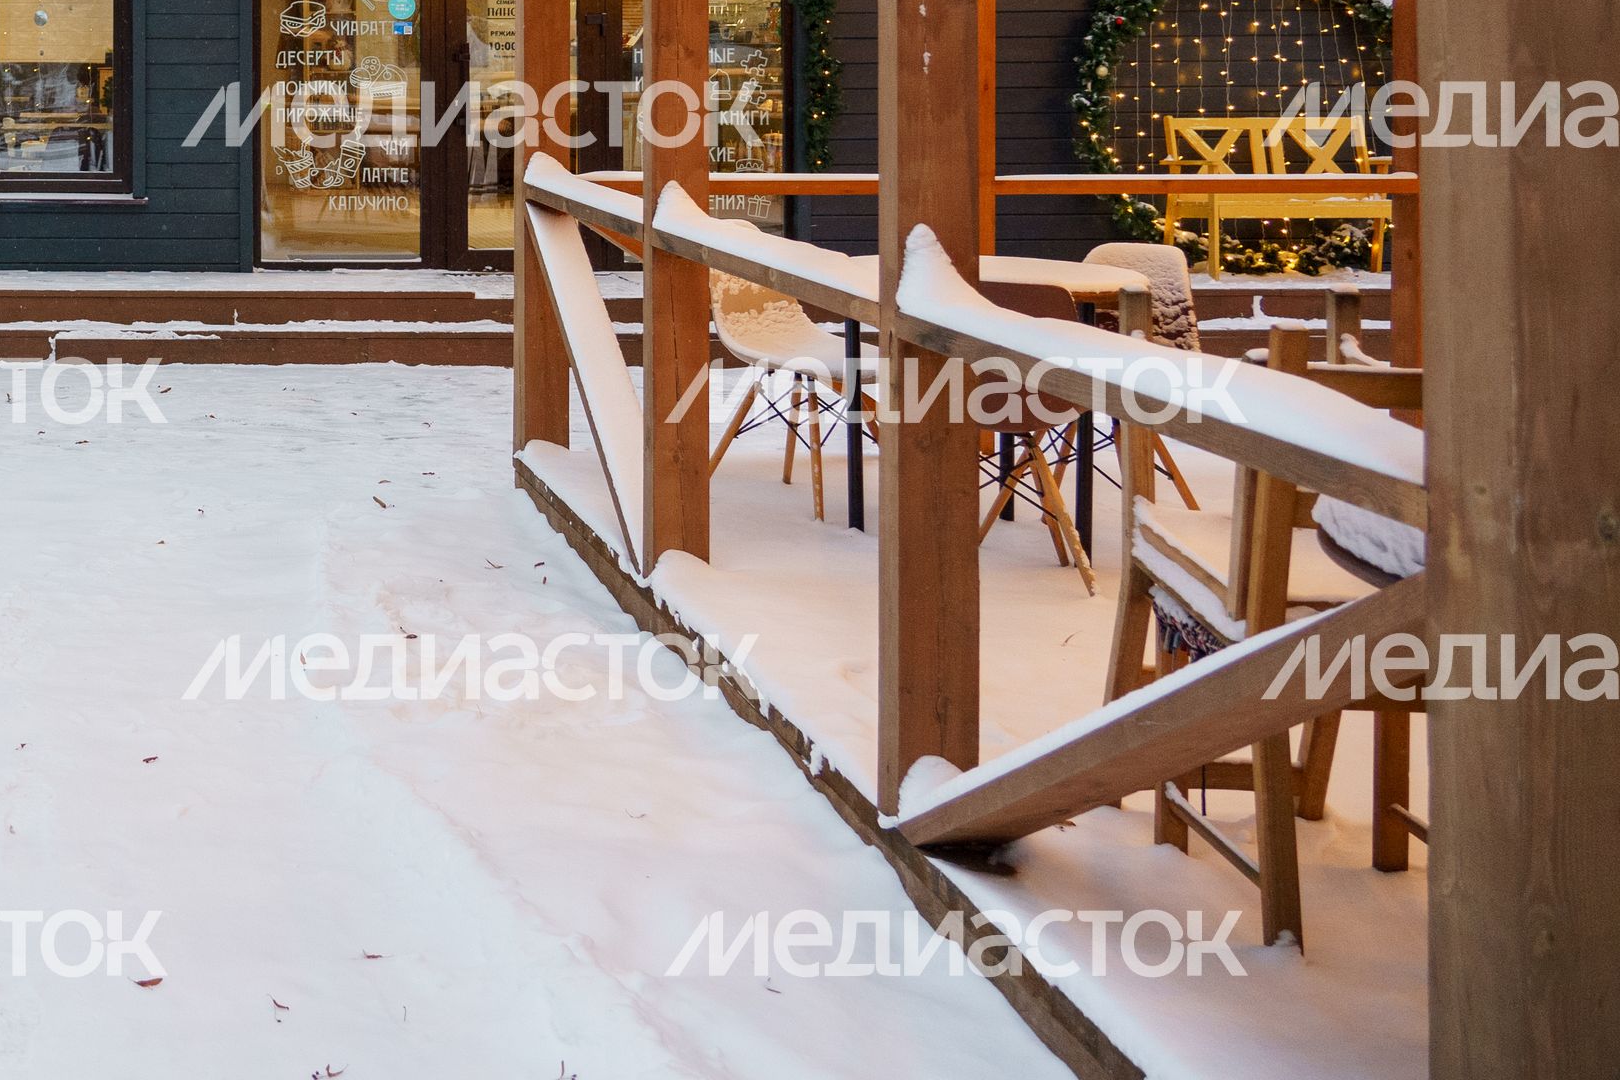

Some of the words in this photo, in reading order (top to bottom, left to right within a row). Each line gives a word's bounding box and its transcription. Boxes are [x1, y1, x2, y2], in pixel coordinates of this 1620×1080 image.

[276, 51, 344, 69] ДЕСЕРТЫ
[276, 81, 347, 96] ПОНЧИКИ
[276, 107, 363, 123] ПИРОЖНЫЕ
[720, 110, 770, 126] КНИГИ
[380, 139, 409, 156] ЧАЙ
[362, 167, 409, 183] ЛАТТЕ
[329, 195, 408, 211] КАПУЧИНО
